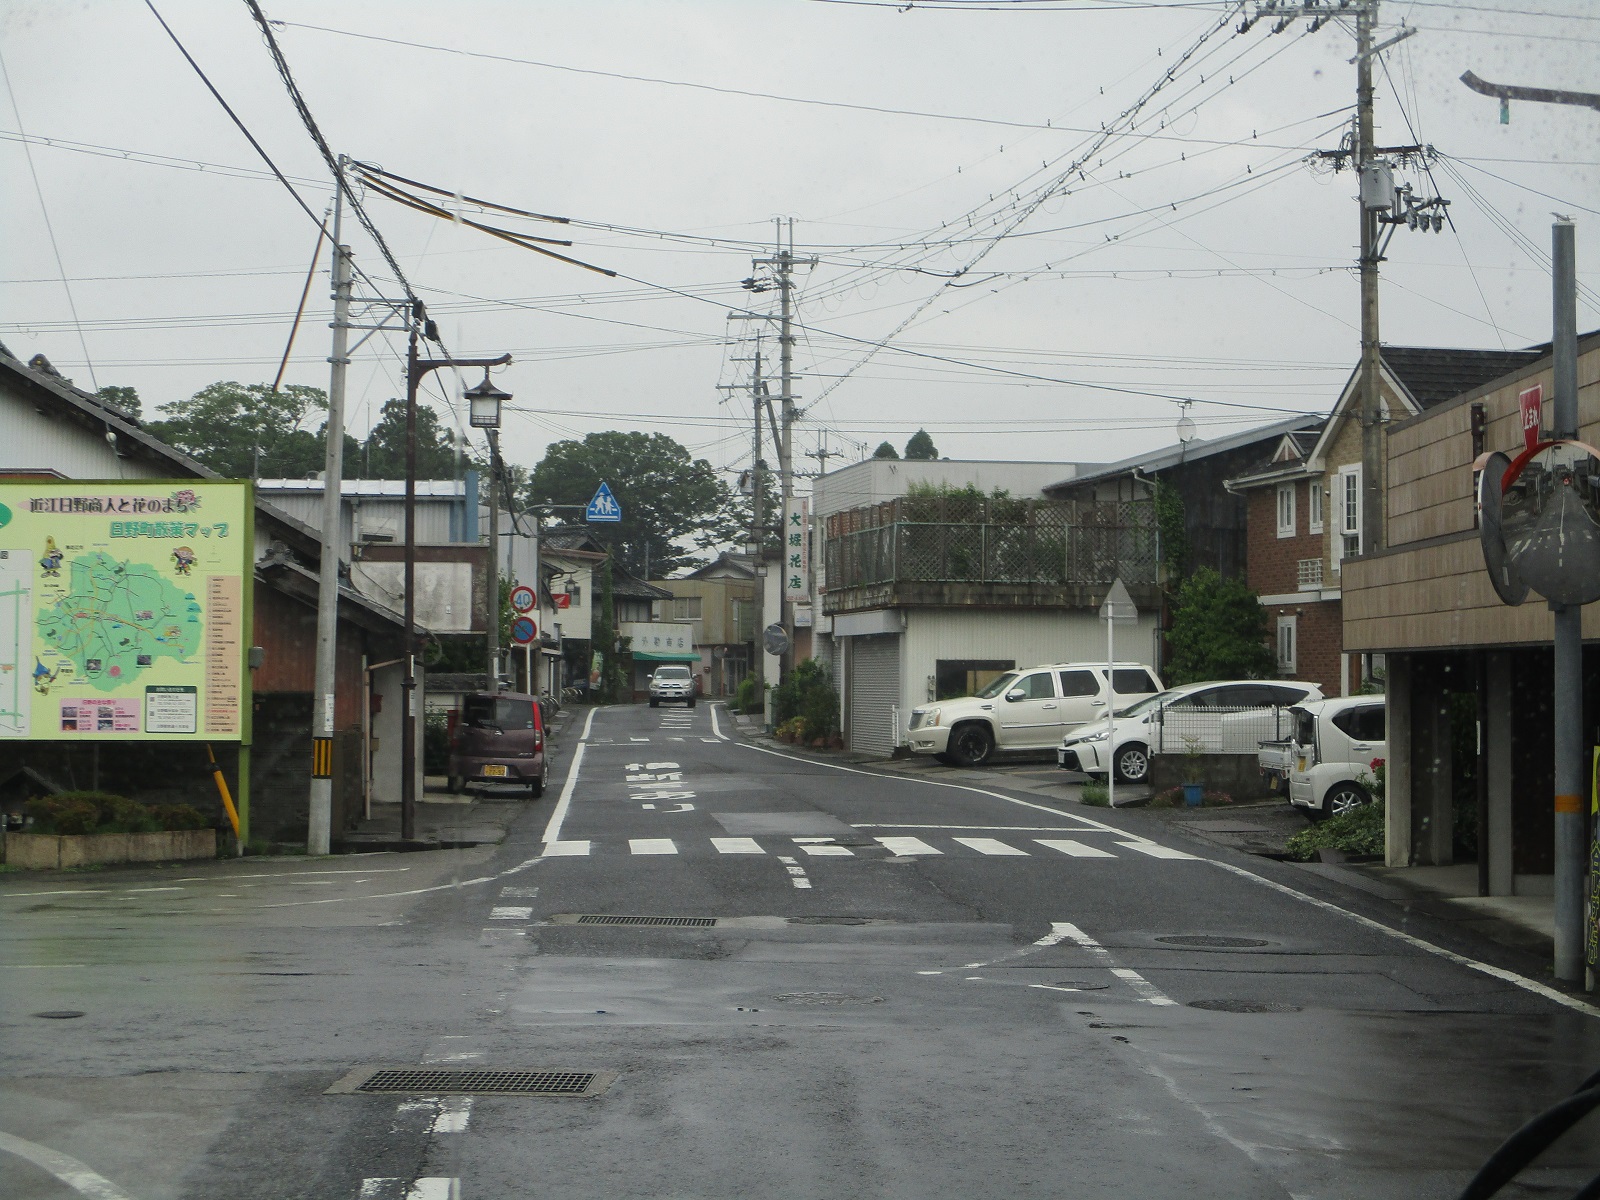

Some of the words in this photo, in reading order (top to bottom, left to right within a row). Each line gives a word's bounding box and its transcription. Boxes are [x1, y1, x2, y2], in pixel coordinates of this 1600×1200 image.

[29, 497, 190, 514] 近江日野商人と花のまち
[109, 521, 230, 538] 日野町散策マップ
[515, 594, 531, 606] 40
